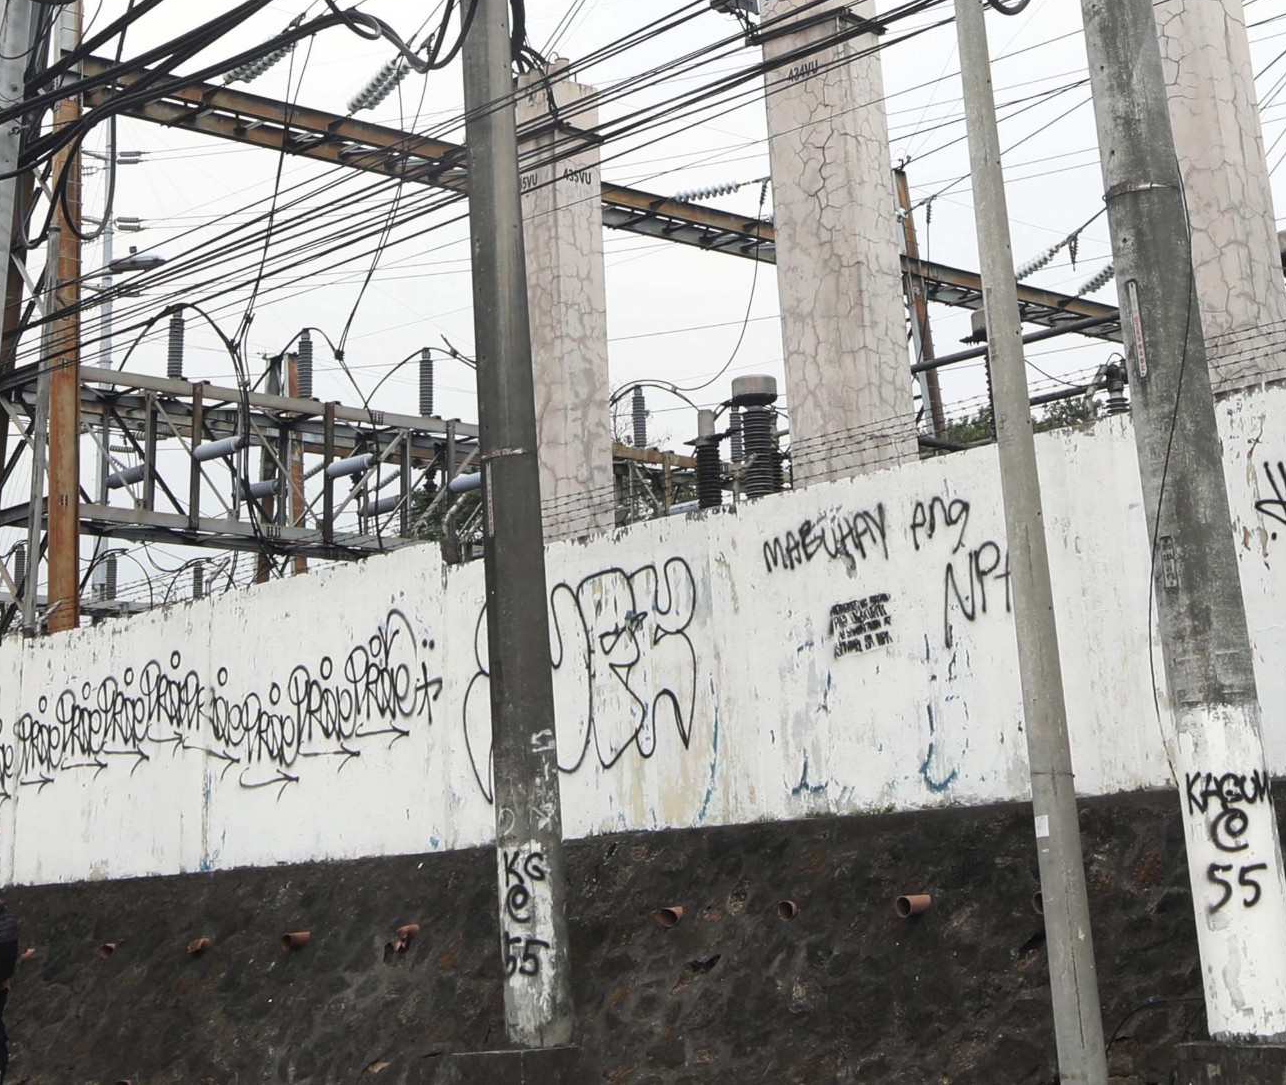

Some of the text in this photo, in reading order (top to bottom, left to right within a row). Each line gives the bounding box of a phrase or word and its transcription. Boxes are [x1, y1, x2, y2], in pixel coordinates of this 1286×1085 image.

[503, 851, 546, 888] KG
[1207, 863, 1268, 915] 55
[504, 930, 550, 978] 55
